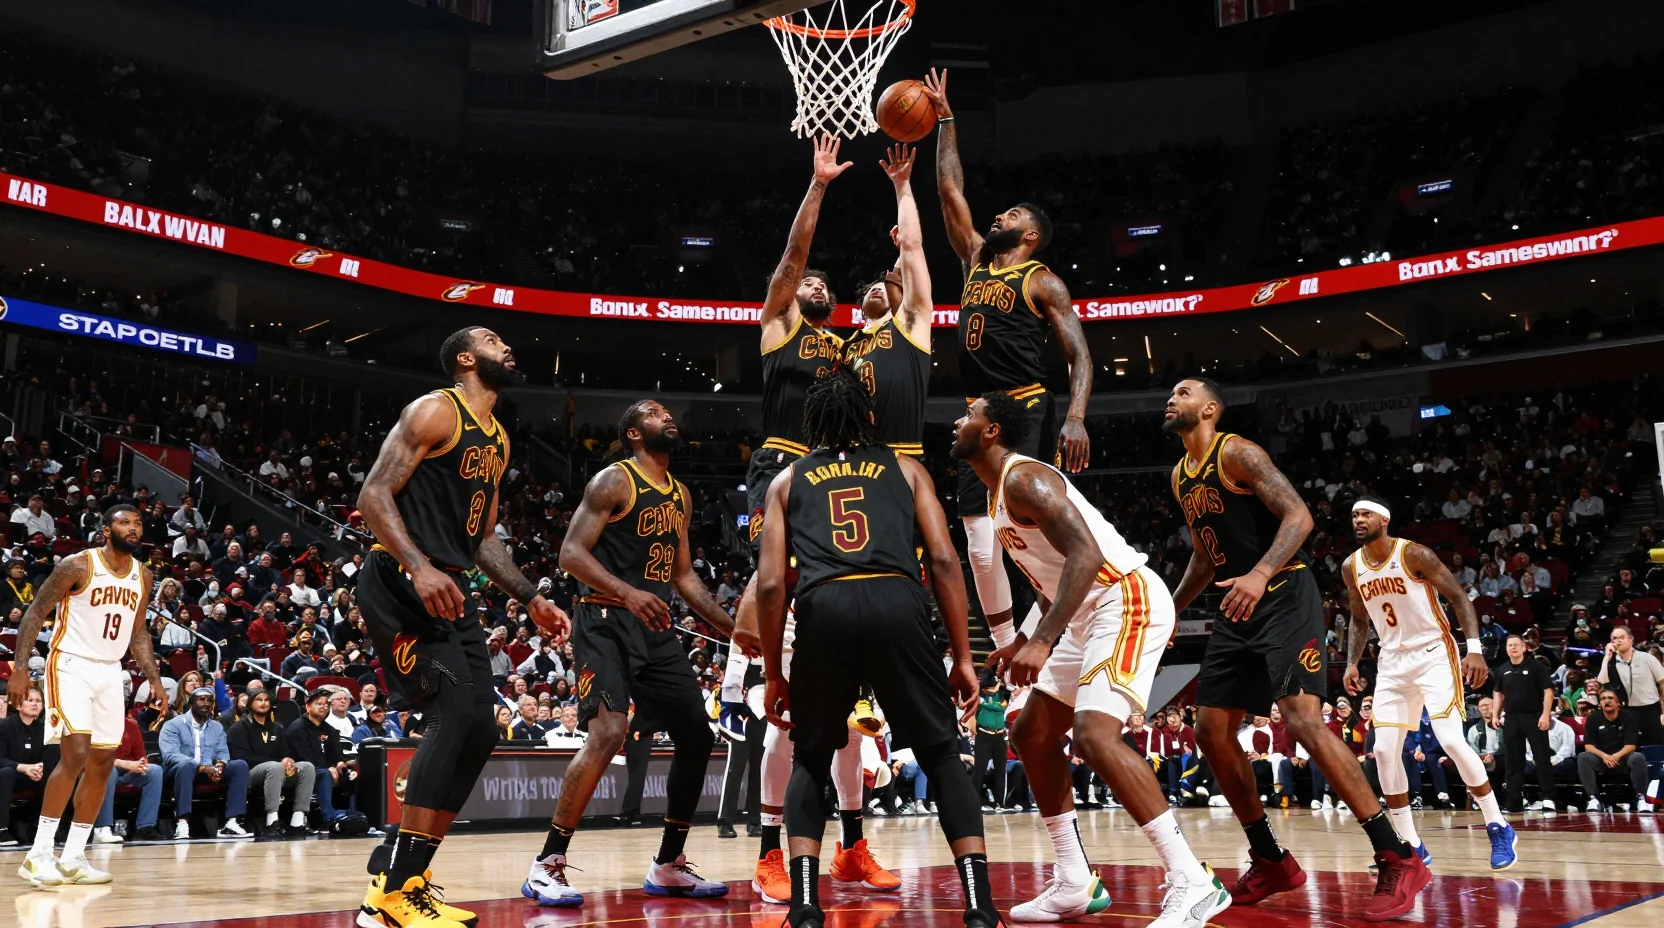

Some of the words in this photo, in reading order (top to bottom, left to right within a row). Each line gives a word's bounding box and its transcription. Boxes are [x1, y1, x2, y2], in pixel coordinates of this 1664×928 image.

[966, 312, 985, 351] 8
[828, 486, 870, 553] 5
[102, 612, 122, 641] 19
[1381, 602, 1398, 628] 3
